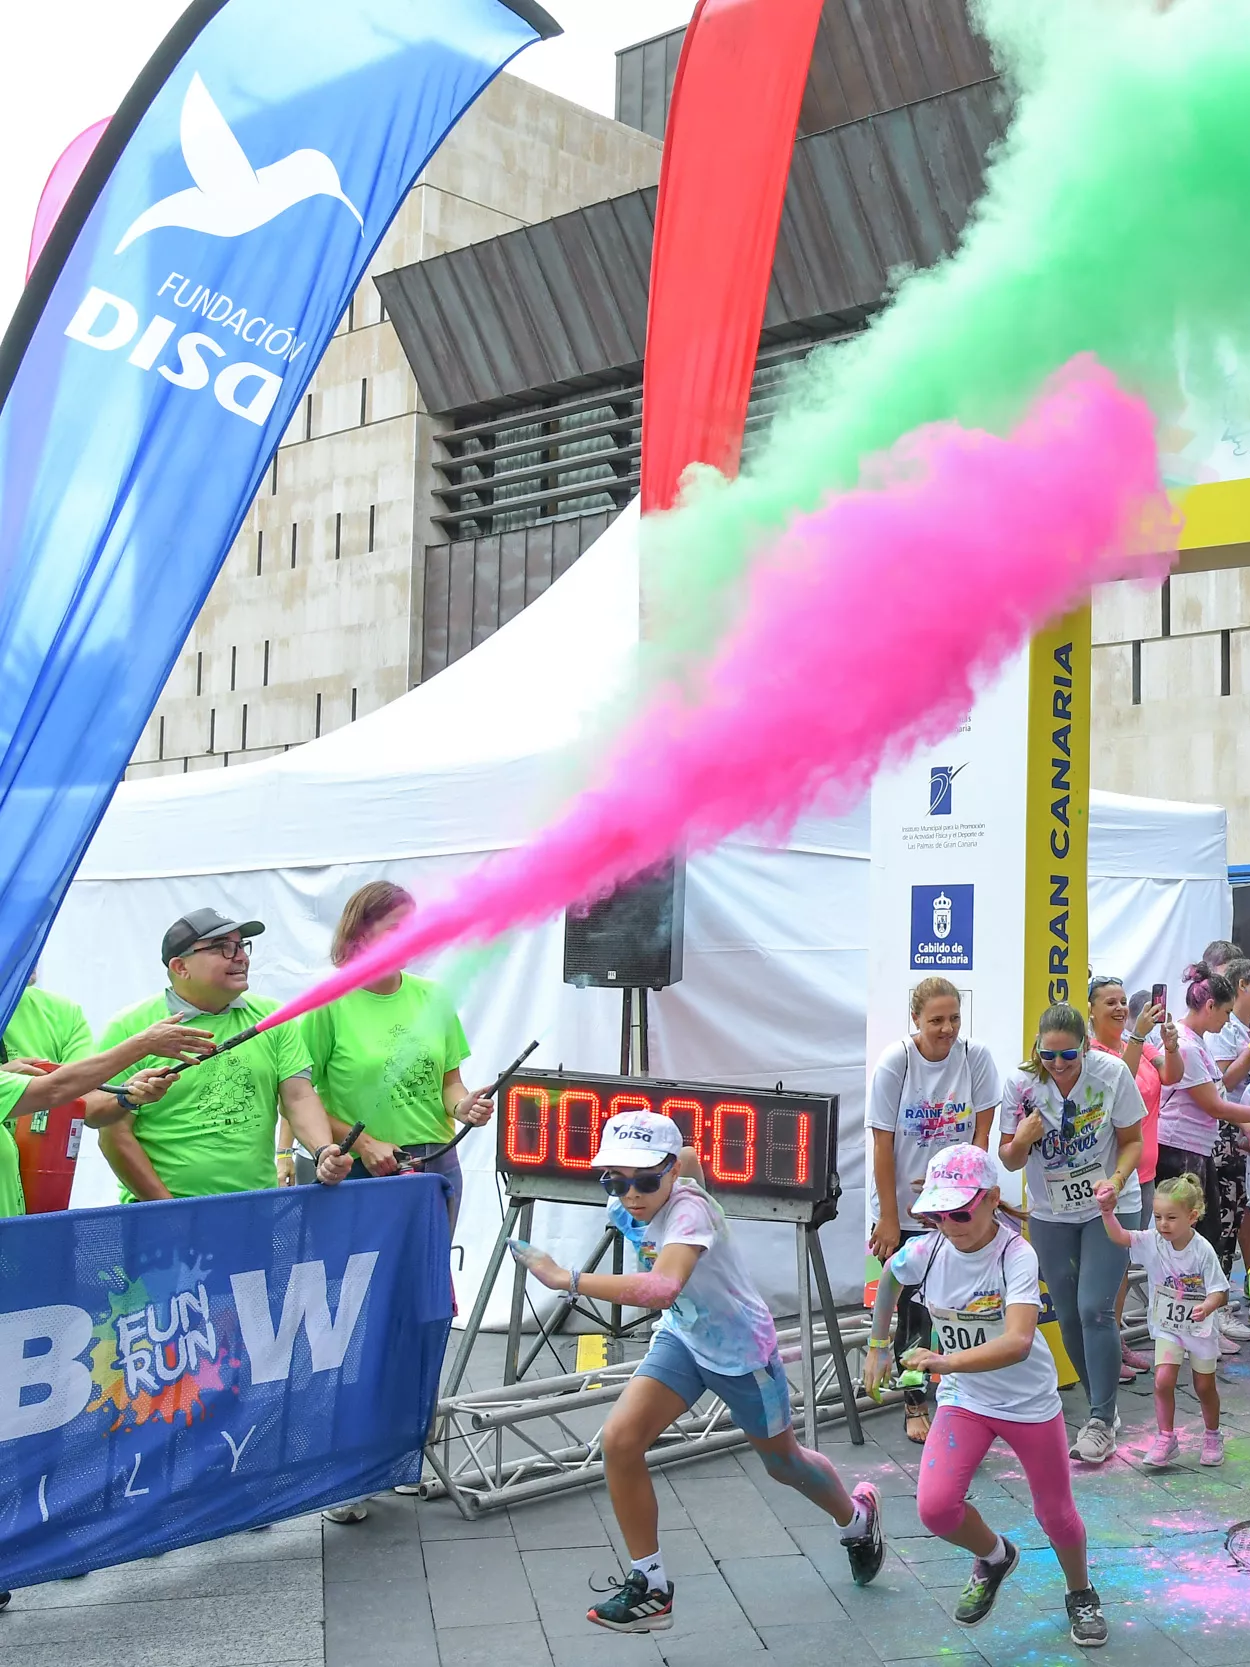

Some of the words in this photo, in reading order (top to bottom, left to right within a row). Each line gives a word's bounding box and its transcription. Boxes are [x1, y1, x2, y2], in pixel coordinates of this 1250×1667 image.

[156, 271, 304, 364] FUNDACIÓN
[1050, 642, 1073, 859] CANARIA
[914, 953, 935, 964] Gran
[936, 953, 968, 964] Canaria
[918, 942, 950, 953] Cabildo
[951, 942, 963, 953] de
[1048, 874, 1069, 1005] GRAN
[1061, 1180, 1094, 1202] 133
[118, 1284, 209, 1352] FUN
[942, 1325, 986, 1350] 304
[123, 1325, 217, 1394] RUN
